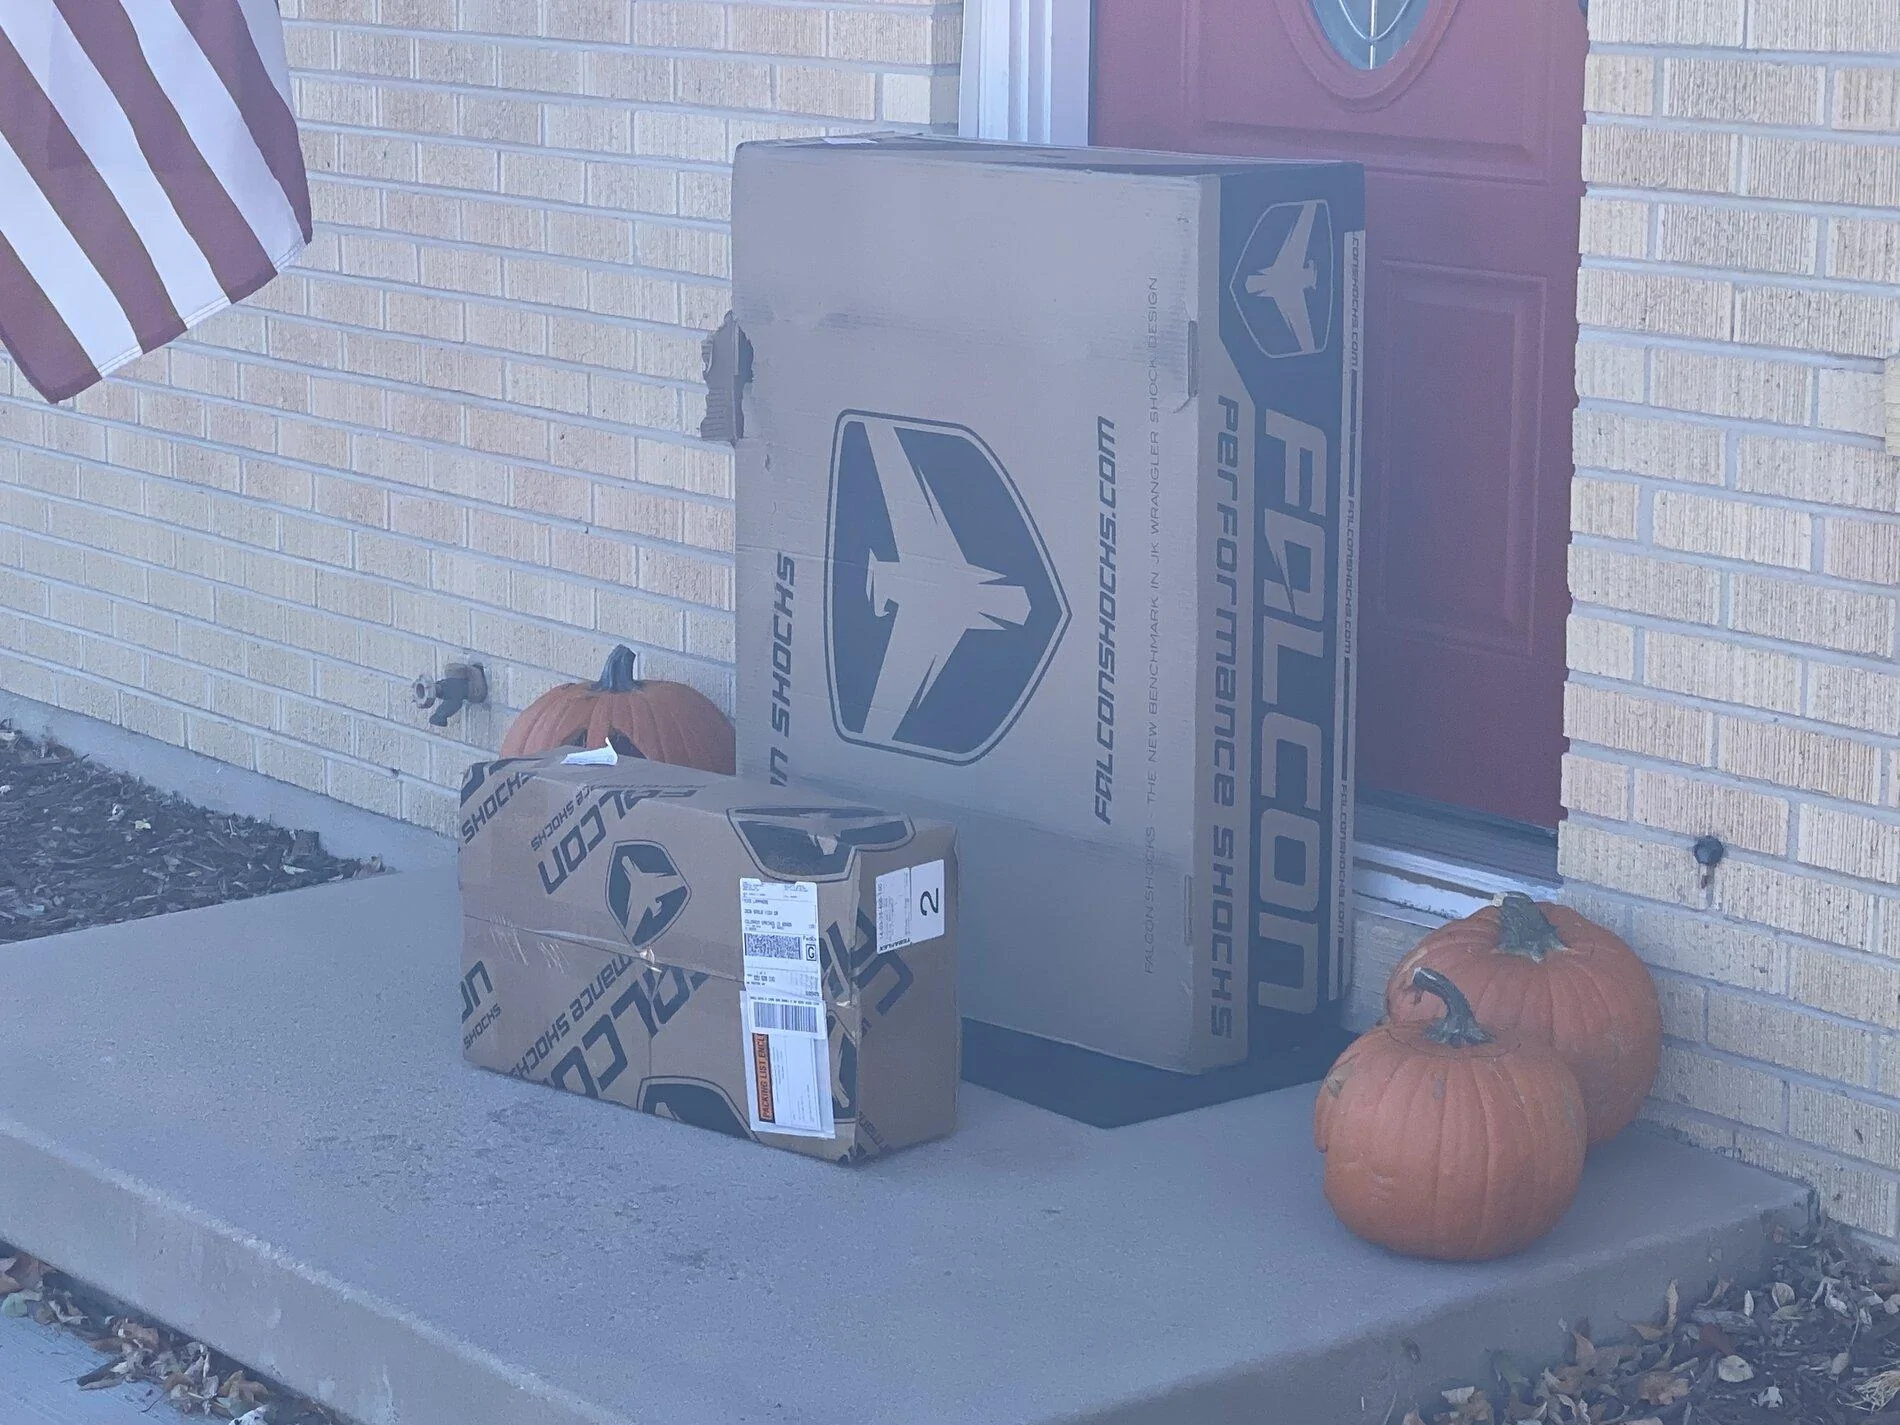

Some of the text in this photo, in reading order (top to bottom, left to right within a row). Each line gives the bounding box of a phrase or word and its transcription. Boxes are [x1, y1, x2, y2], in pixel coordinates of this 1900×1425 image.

[1147, 276, 1158, 350] DESIGN
[1148, 352, 1159, 424] SHOCK
[1150, 430, 1160, 535] WRANGLER
[1150, 538, 1159, 565] JK
[1150, 571, 1159, 590] IN
[771, 551, 796, 738] SHOCKS
[1093, 415, 1118, 826] FALCONSHOCKS.COM
[1148, 595, 1159, 715] BENCHMARK
[1147, 720, 1158, 763] NEW
[1257, 408, 1328, 1015] FALCON
[1146, 772, 1157, 804] THE
[530, 804, 576, 852] SHOCKS
[919, 887, 939, 917] 2
[1210, 823, 1235, 1040] SHOCKS
[807, 945, 816, 960] G
[462, 1002, 503, 1051] SHOCKS
[756, 1034, 770, 1119] PACKING LIST ENCL
